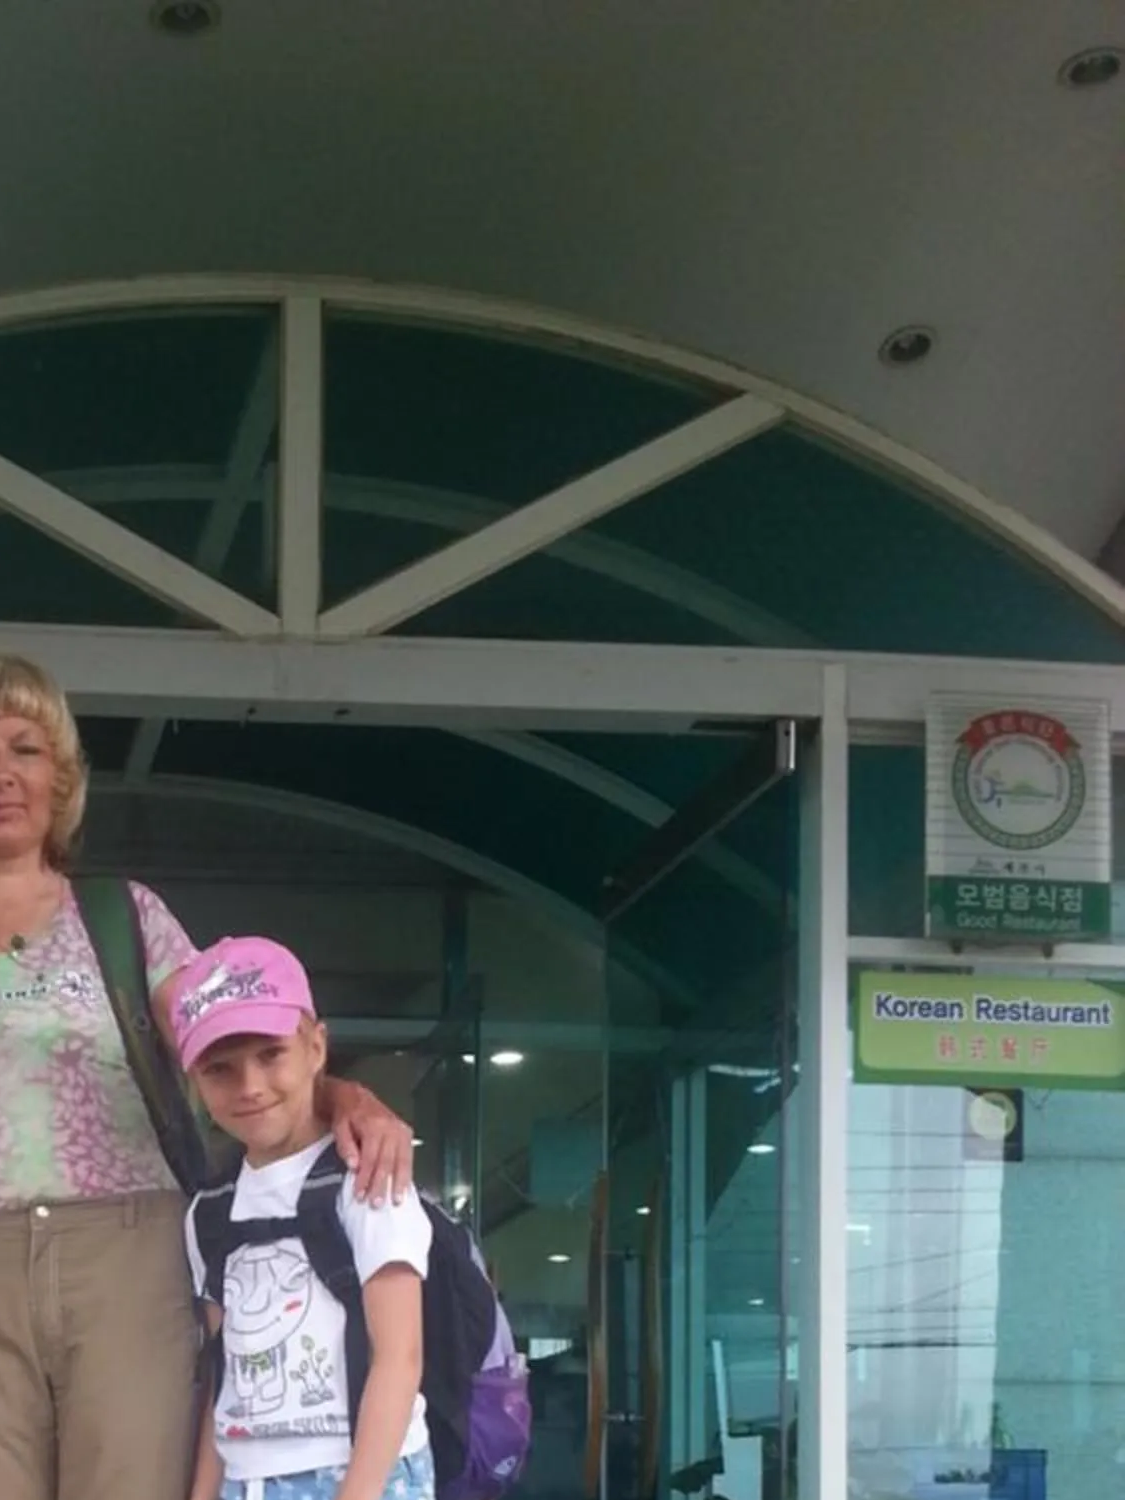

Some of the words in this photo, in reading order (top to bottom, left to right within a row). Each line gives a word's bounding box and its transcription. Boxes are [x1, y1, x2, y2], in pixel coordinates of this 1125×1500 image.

[955, 883, 1083, 914] 모범음식점
[956, 911, 997, 929] Good
[1001, 913, 1081, 931] Restaurant
[875, 994, 964, 1019] Korean
[975, 997, 1110, 1025] Restaurant
